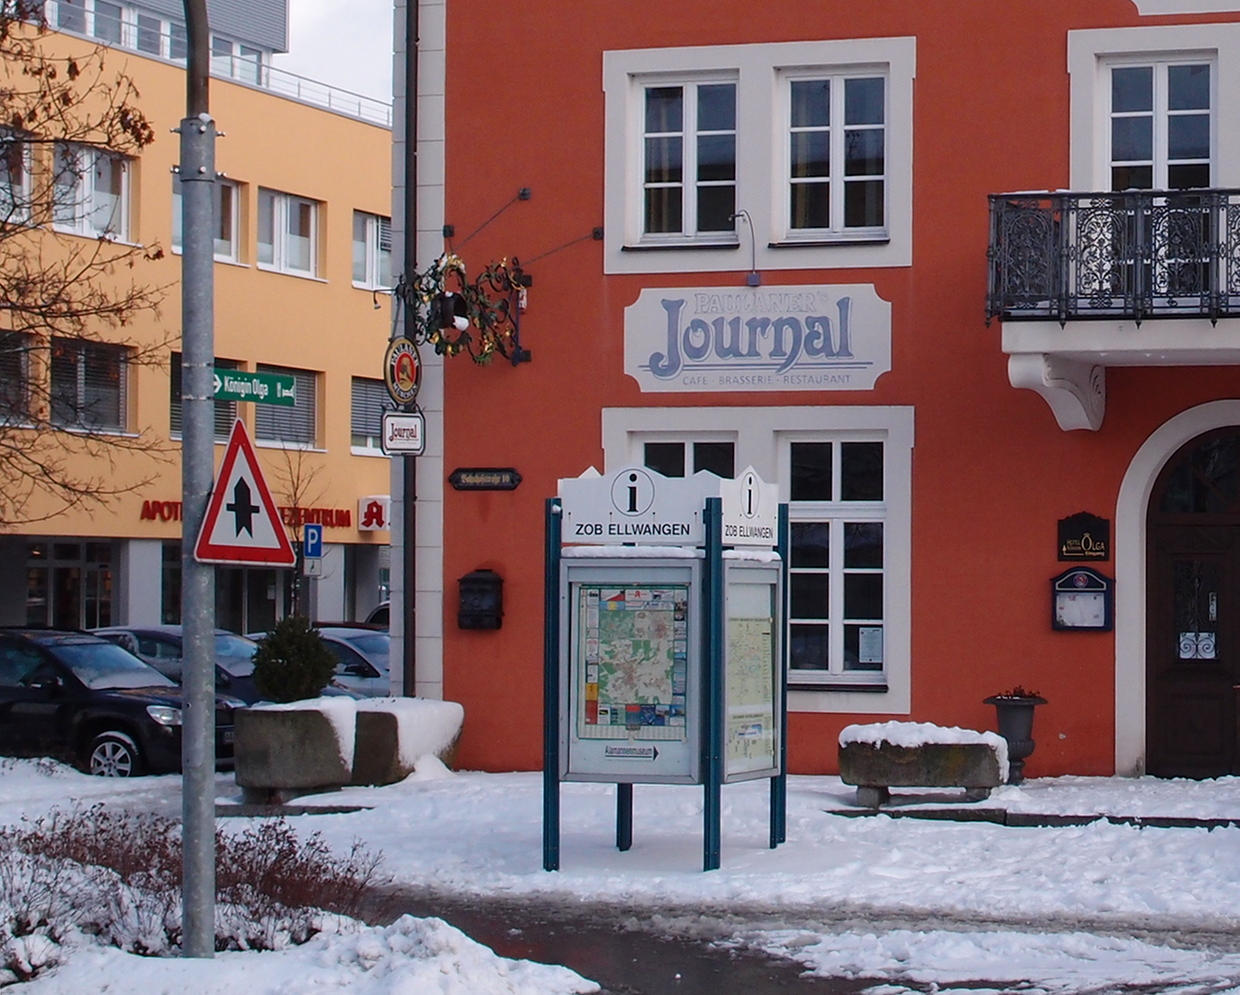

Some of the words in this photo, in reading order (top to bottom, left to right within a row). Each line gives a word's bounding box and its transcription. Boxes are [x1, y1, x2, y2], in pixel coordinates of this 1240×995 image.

[649, 296, 854, 380] Journal
[224, 375, 251, 398] Königin
[252, 378, 268, 399] Olga
[719, 375, 773, 385] BRASSERIE
[783, 374, 851, 385] RESTAURANT
[388, 422, 418, 441] Journal
[575, 523, 603, 536] ZOB
[608, 523, 690, 536] ELLWANGEN
[725, 524, 738, 537] ZOB
[739, 525, 773, 539] ELLWANGEN
[1081, 533, 1105, 551] OLGA
